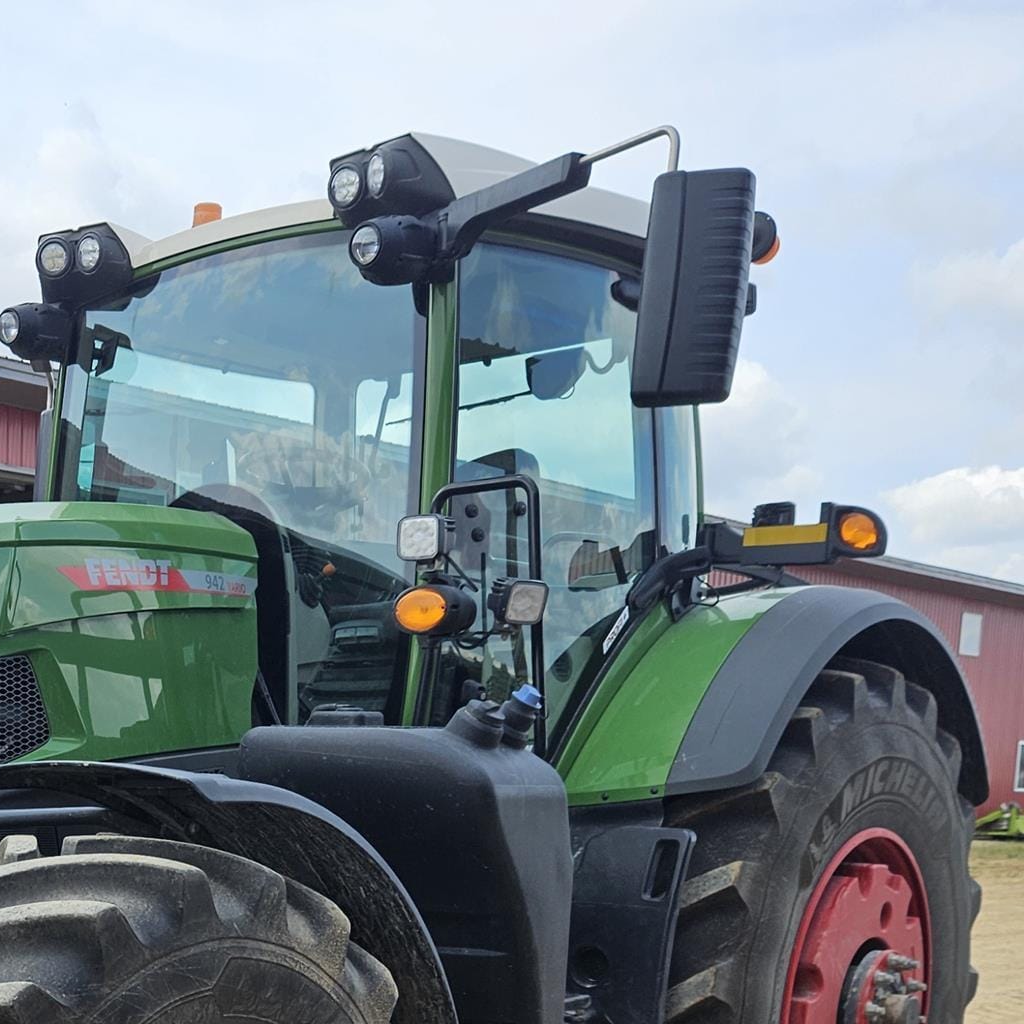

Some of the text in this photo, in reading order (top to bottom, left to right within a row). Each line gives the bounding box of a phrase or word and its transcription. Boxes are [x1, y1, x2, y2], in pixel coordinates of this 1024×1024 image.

[84, 558, 171, 586] FENDT
[205, 574, 225, 591] 942
[840, 759, 950, 831] MICHELIN
